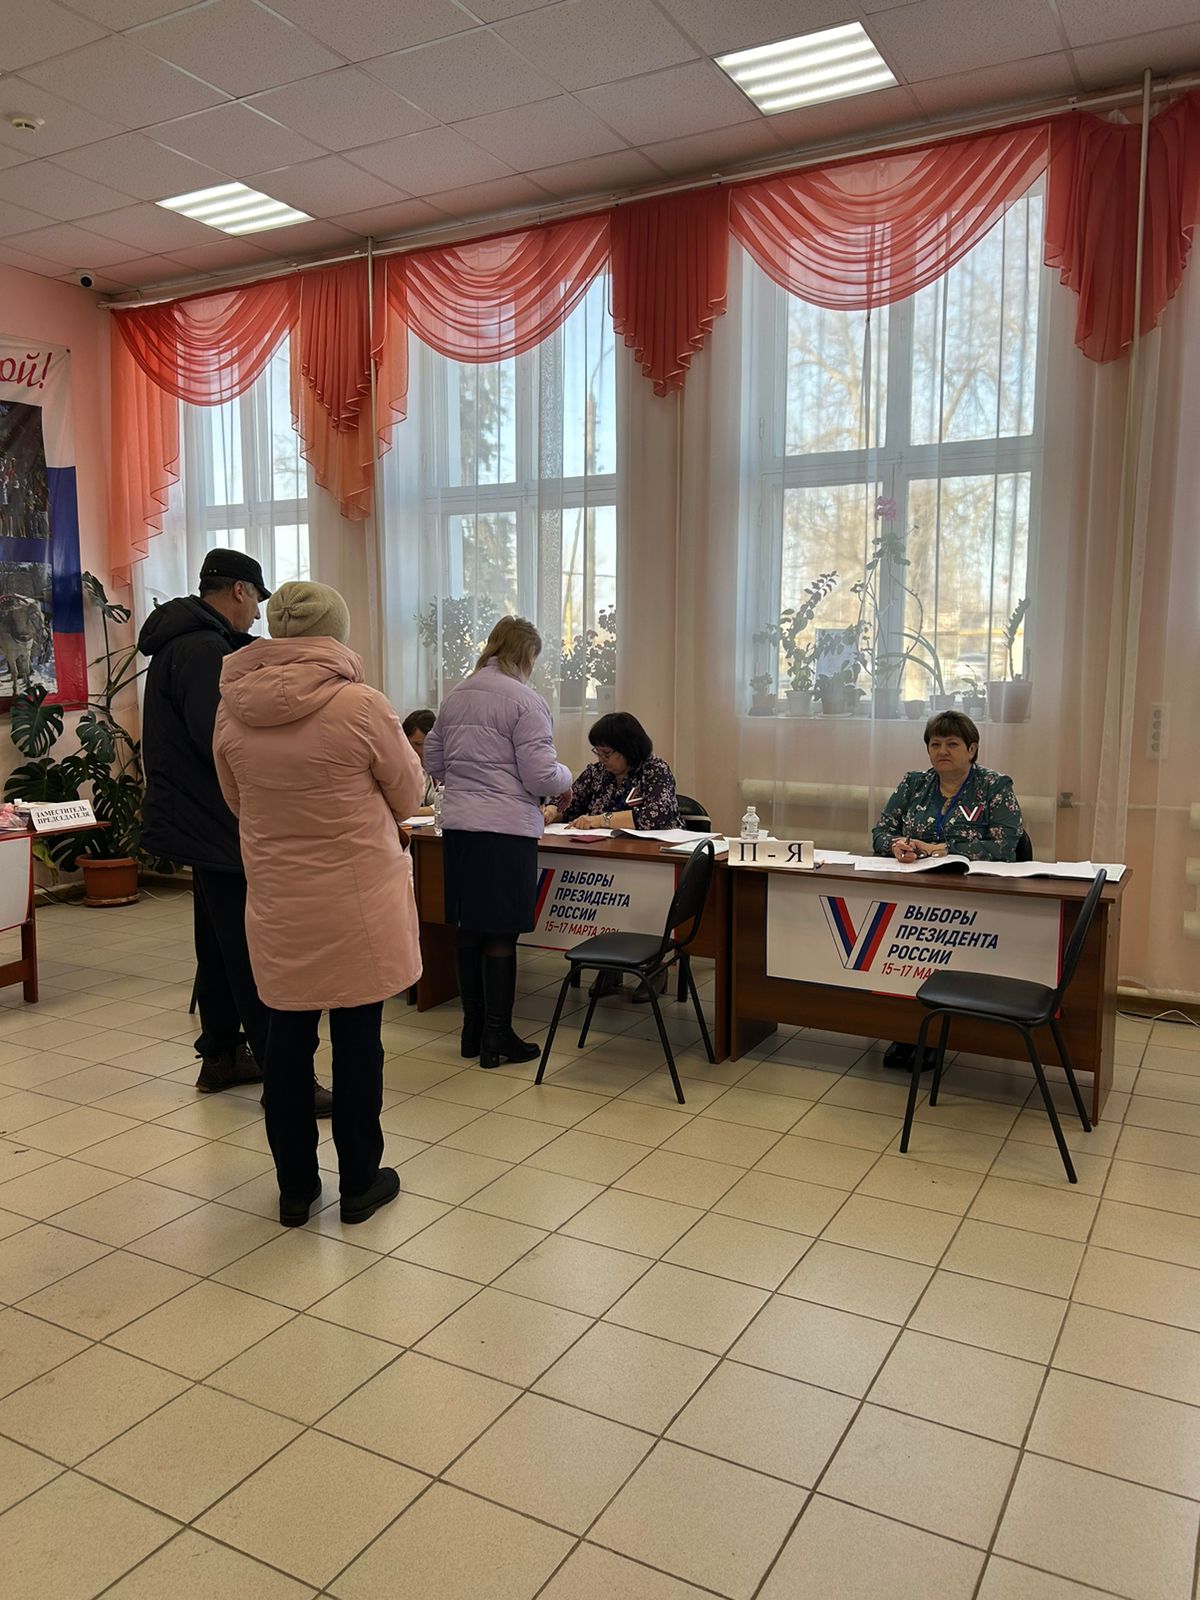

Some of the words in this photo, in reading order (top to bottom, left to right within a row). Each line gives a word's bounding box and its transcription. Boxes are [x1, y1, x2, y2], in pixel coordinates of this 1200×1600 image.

[36, 805, 87, 818] ЗАМЕСТИТЕЛЬ
[37, 811, 91, 824] ПРЕДСЕДАТЕЛЯ
[738, 842, 759, 862] П
[785, 842, 804, 863] Я
[561, 870, 615, 887] ВЫБОРЫ
[554, 887, 631, 908] ПРЕЗИДЕНТА
[549, 904, 598, 921] РОССИИ
[903, 904, 978, 926] ВЫБОРЫ
[569, 923, 598, 937] МАРТА
[895, 925, 999, 950] ПРЕЗИДЕНТА
[887, 944, 953, 965] РОССИИ
